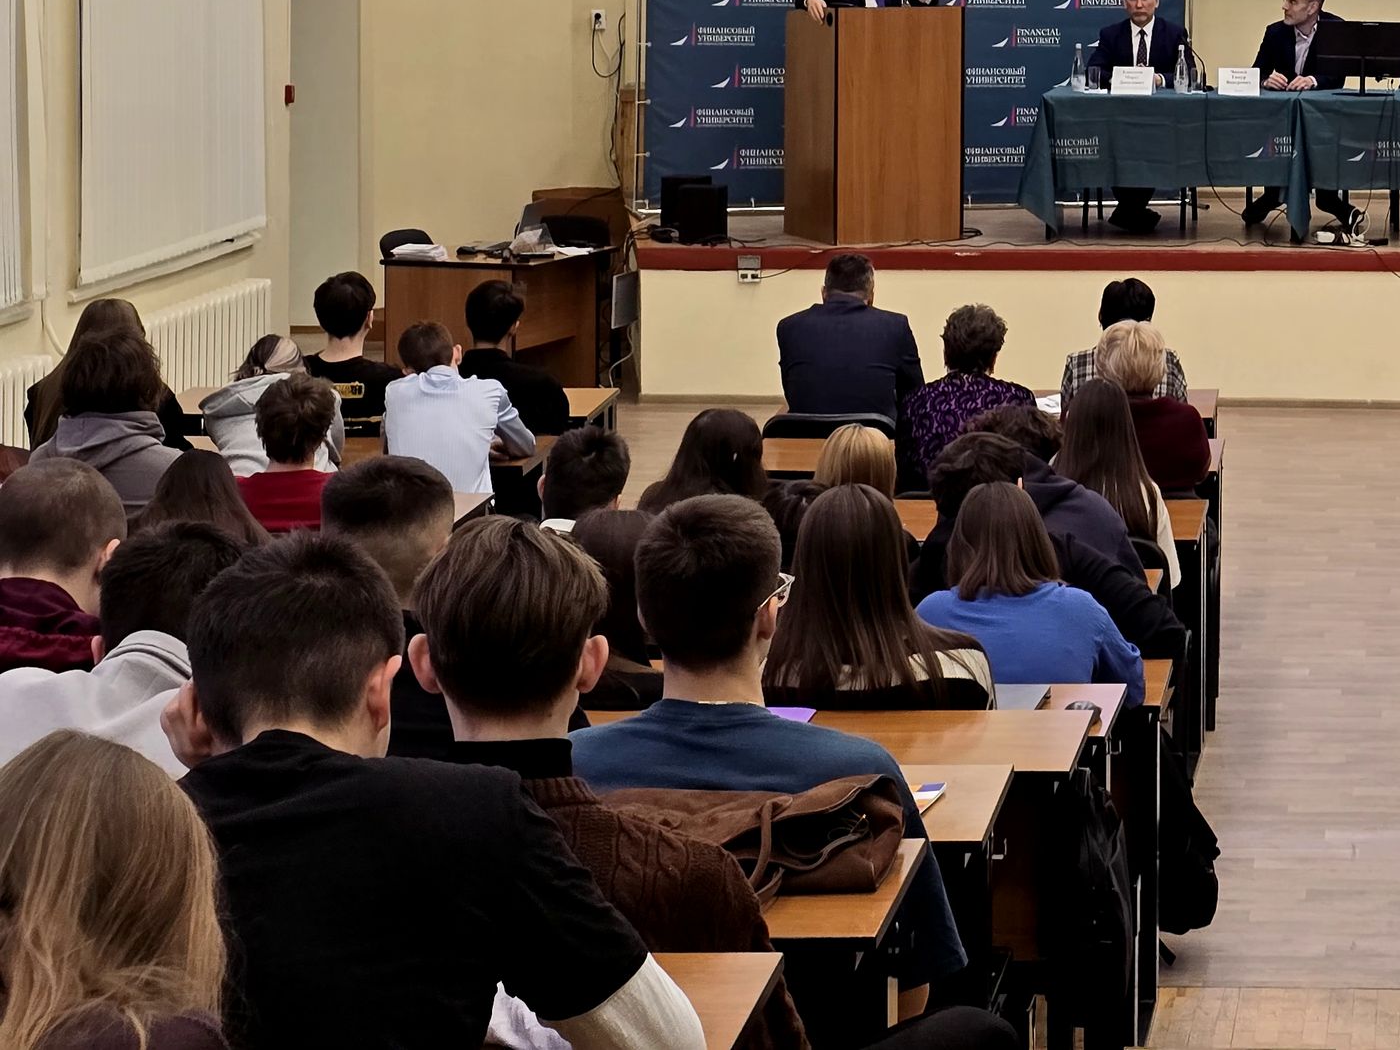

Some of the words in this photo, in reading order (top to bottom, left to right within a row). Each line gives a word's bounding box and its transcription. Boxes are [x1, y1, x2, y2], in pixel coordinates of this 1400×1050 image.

[1017, 28, 1061, 36] FINANCIAL
[741, 67, 785, 76] ФИНАНСО
[741, 76, 785, 84] УНИВЕРС
[740, 149, 784, 157] ФИНАНСО
